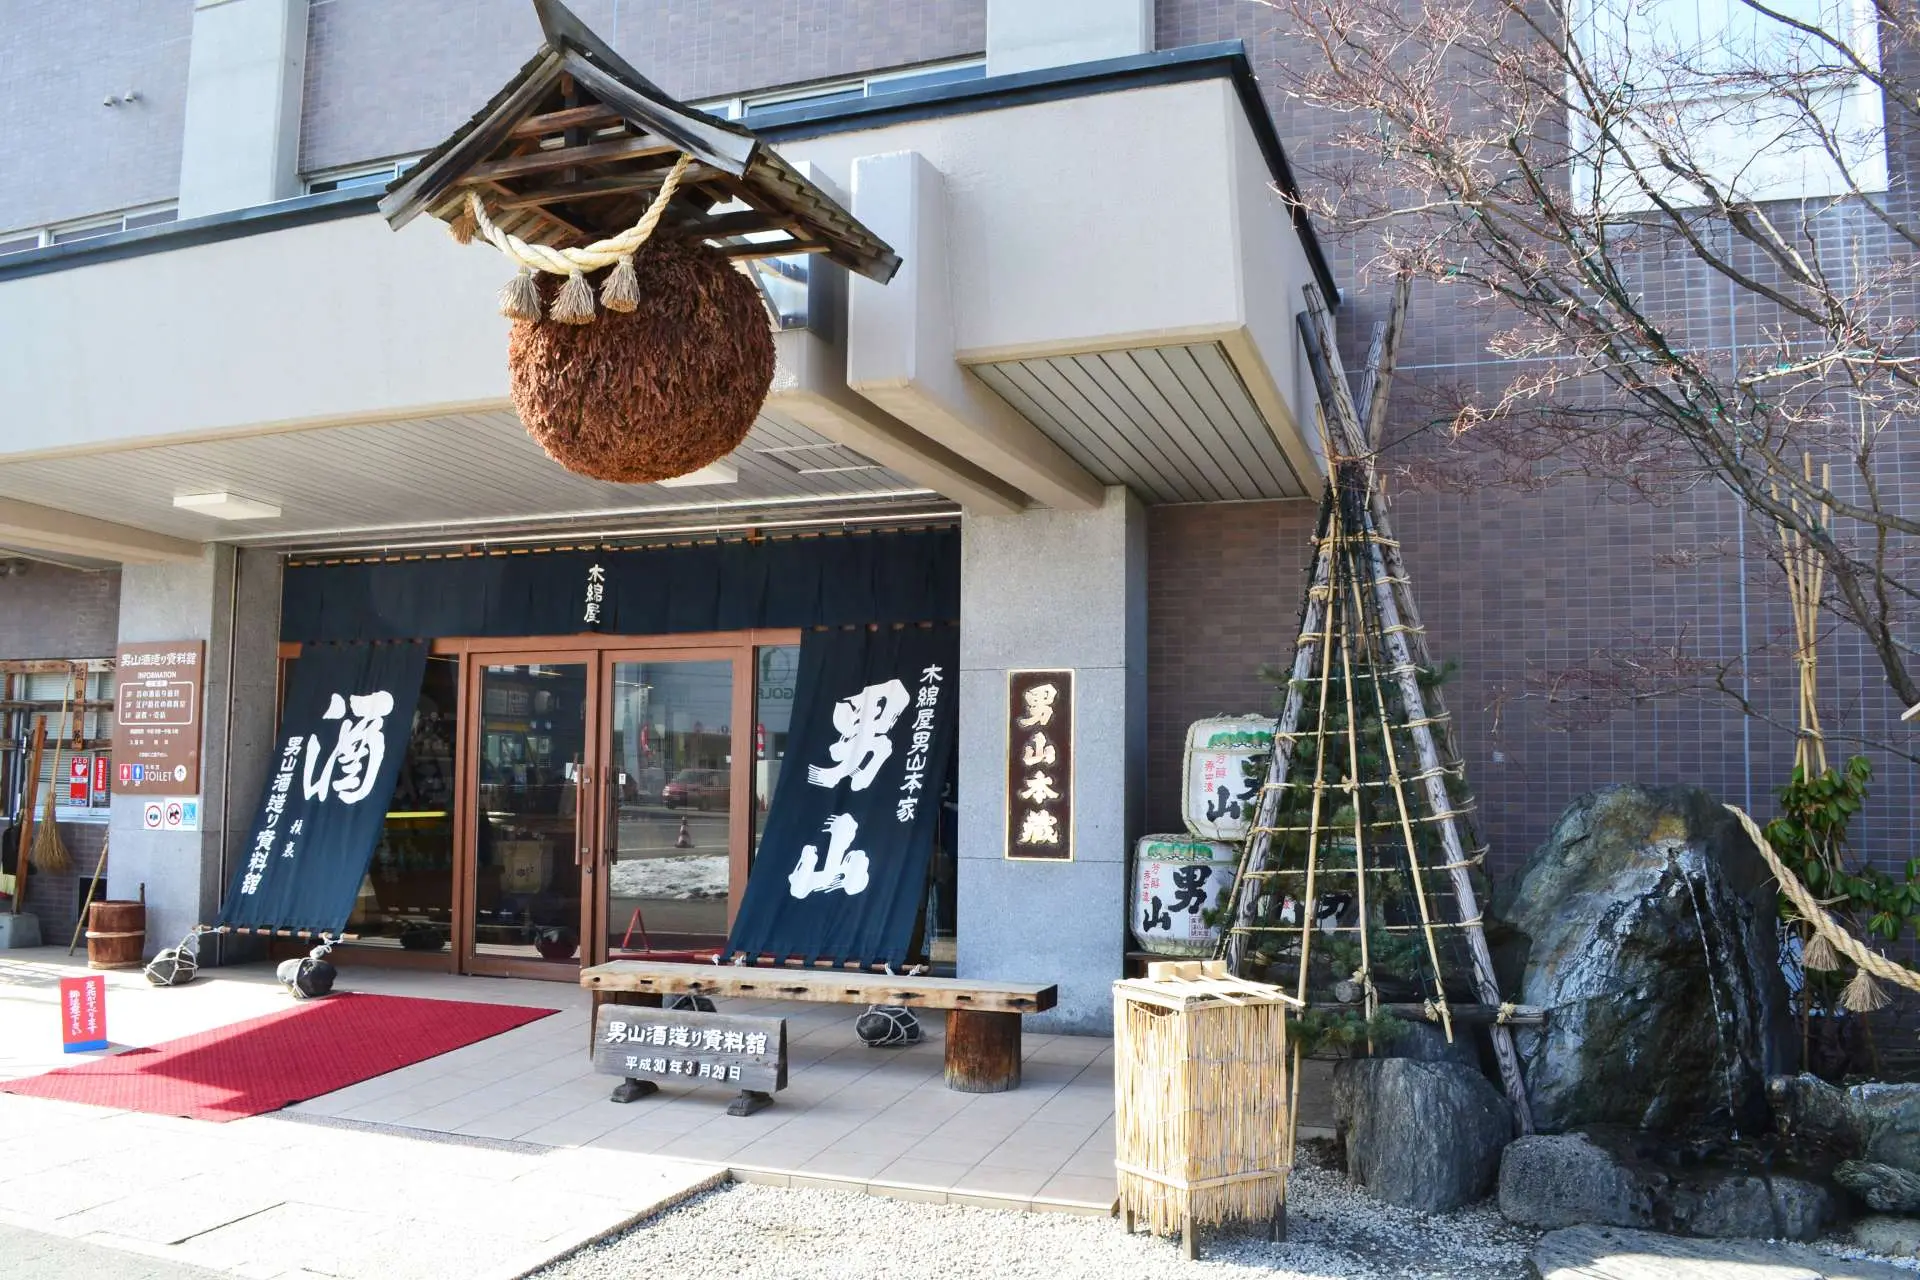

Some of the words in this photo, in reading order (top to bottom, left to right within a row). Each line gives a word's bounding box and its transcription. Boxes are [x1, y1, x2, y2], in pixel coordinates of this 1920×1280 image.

[584, 563, 605, 624] 木綿屋
[121, 652, 197, 667] 男山酒造り資料館
[137, 671, 177, 680] INFORMATION
[302, 690, 395, 805] 酒
[895, 663, 944, 823] 木綿屋男山本家
[145, 771, 172, 782] TOILET
[788, 678, 911, 900] 男山
[240, 735, 304, 895] 男山酒造り資料館
[1142, 864, 1213, 933] 男山
[605, 1021, 768, 1055] 男山酒造り資料館
[625, 1055, 741, 1081] 平成30年3月29日
